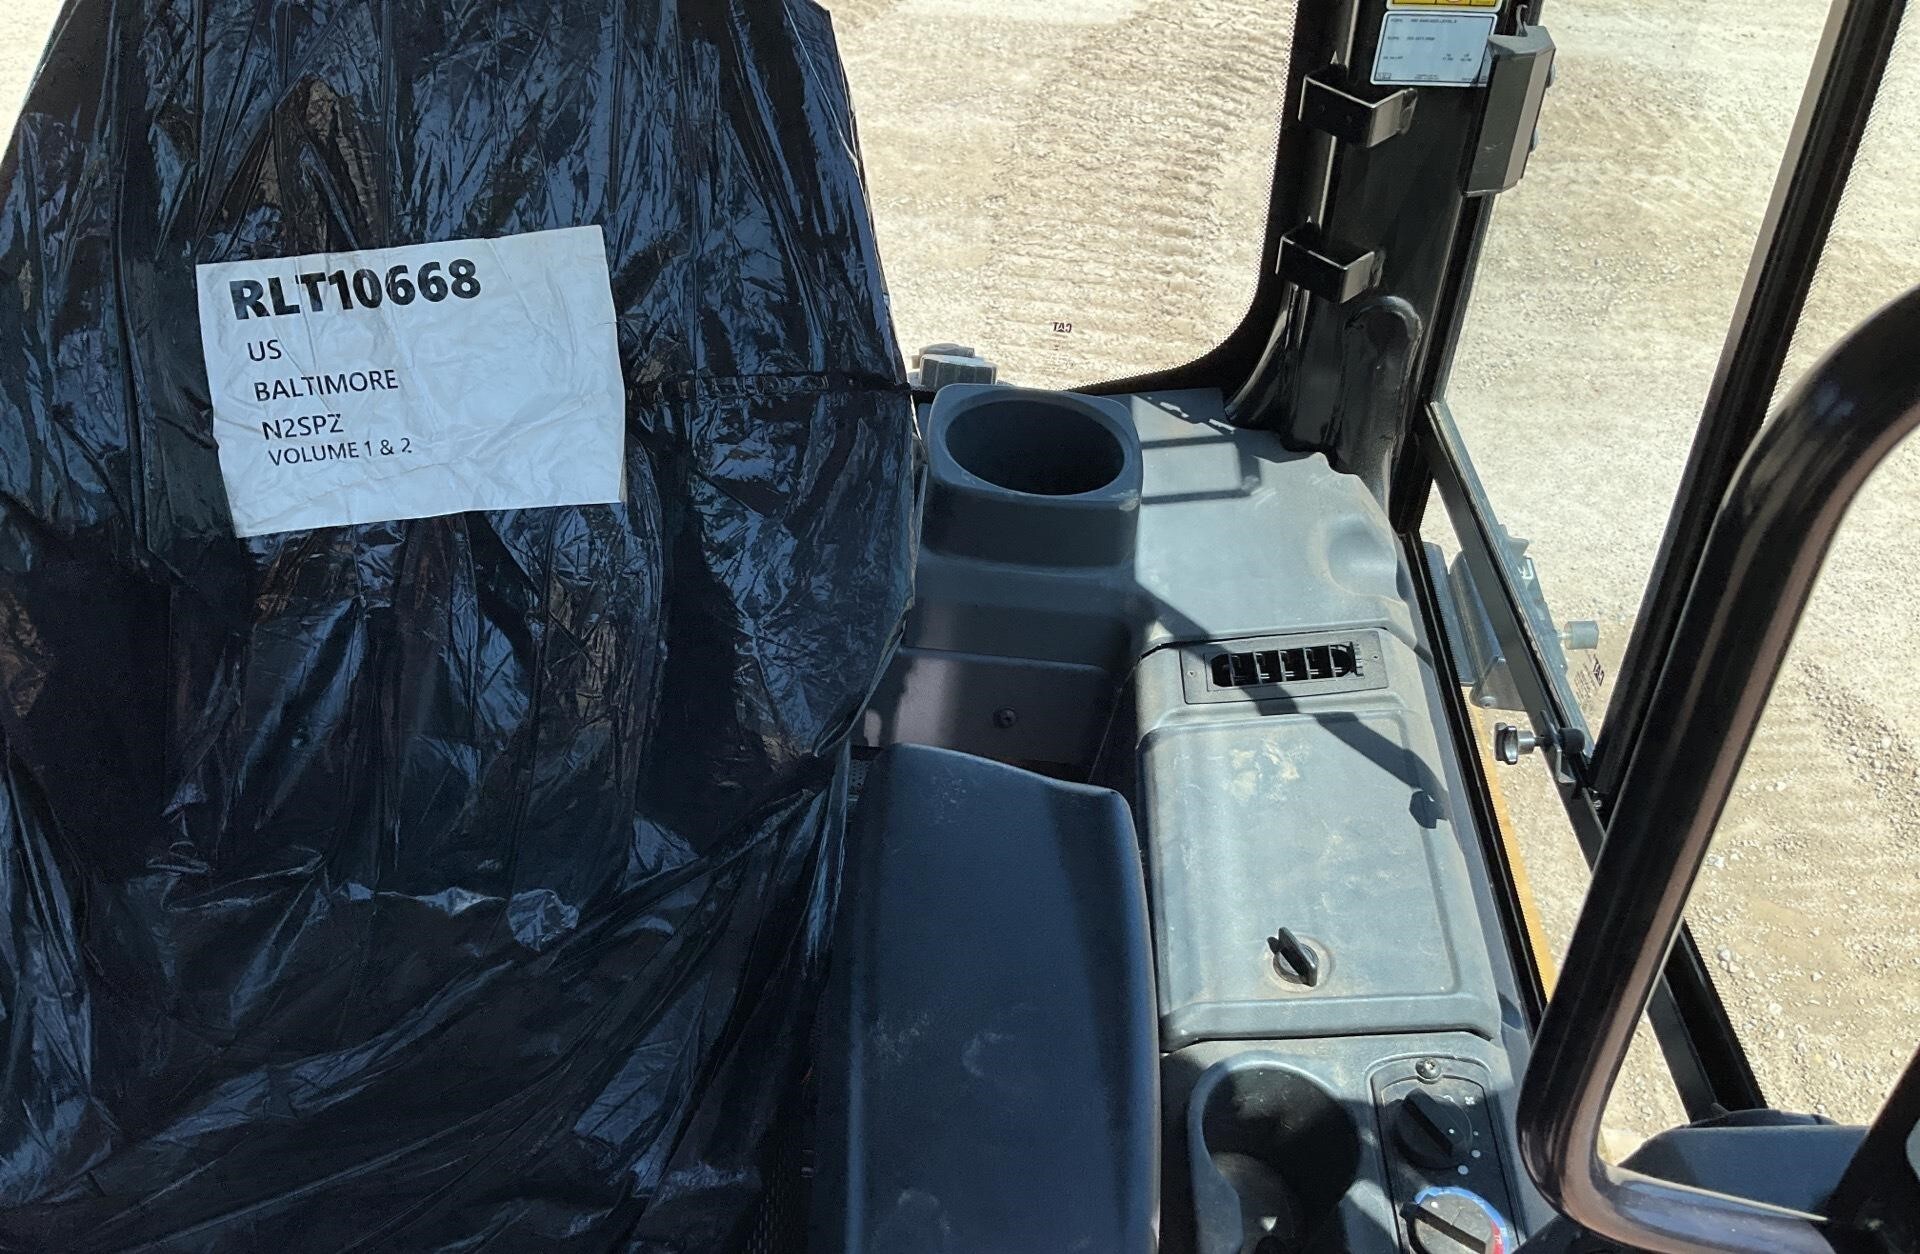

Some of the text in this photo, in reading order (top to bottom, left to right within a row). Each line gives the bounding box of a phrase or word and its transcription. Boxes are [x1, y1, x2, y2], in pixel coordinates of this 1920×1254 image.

[229, 258, 482, 321] RLT10668
[247, 339, 282, 362] US
[254, 369, 399, 402] BALTIMORE
[261, 413, 344, 441] N2SPZ
[268, 436, 413, 467] VOLUME 1 & 2
